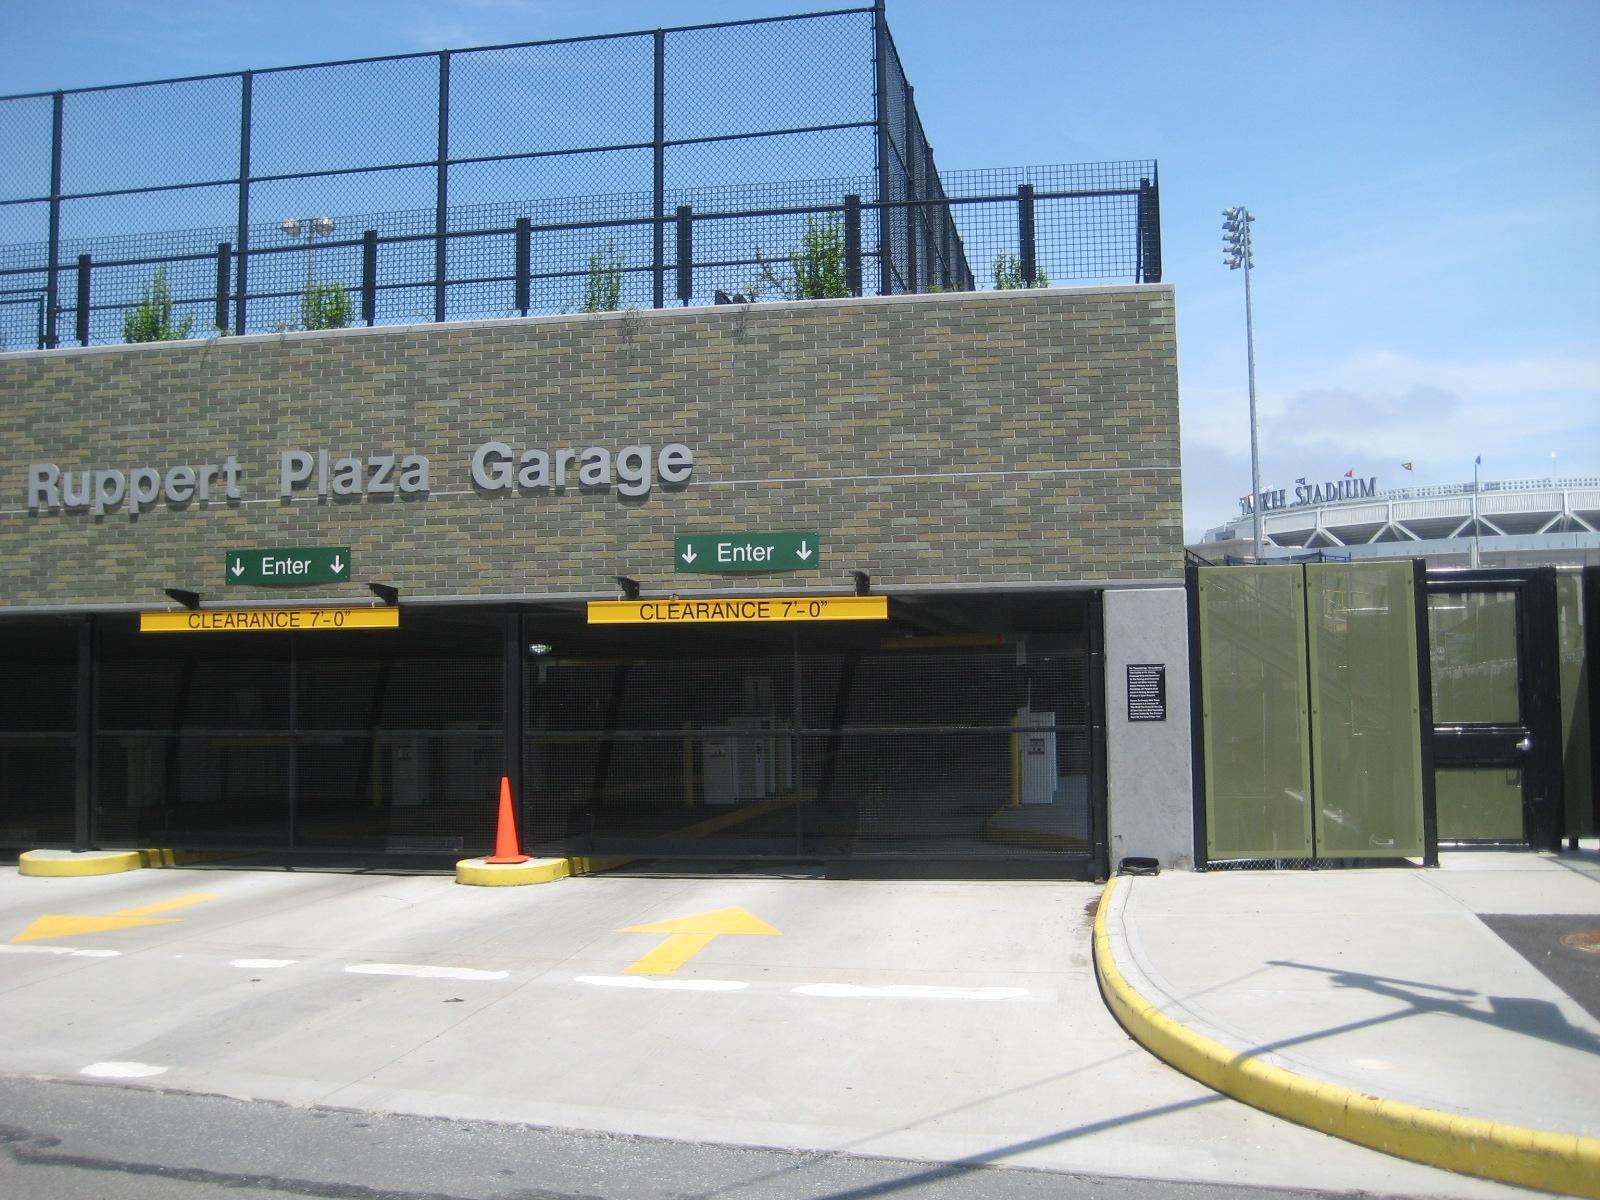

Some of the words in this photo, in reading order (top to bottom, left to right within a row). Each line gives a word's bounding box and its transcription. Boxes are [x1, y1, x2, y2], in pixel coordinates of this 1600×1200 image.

[28, 456, 242, 517] Ruppert
[280, 447, 431, 500] Plaza
[471, 440, 694, 497] Garage
[1240, 488, 1287, 515] YAKEE
[1295, 477, 1377, 506] STADIUM
[717, 542, 775, 563] Enter
[262, 556, 312, 576] Enter
[188, 611, 301, 630] CLEARANCE
[639, 601, 770, 621] CLEARANCE
